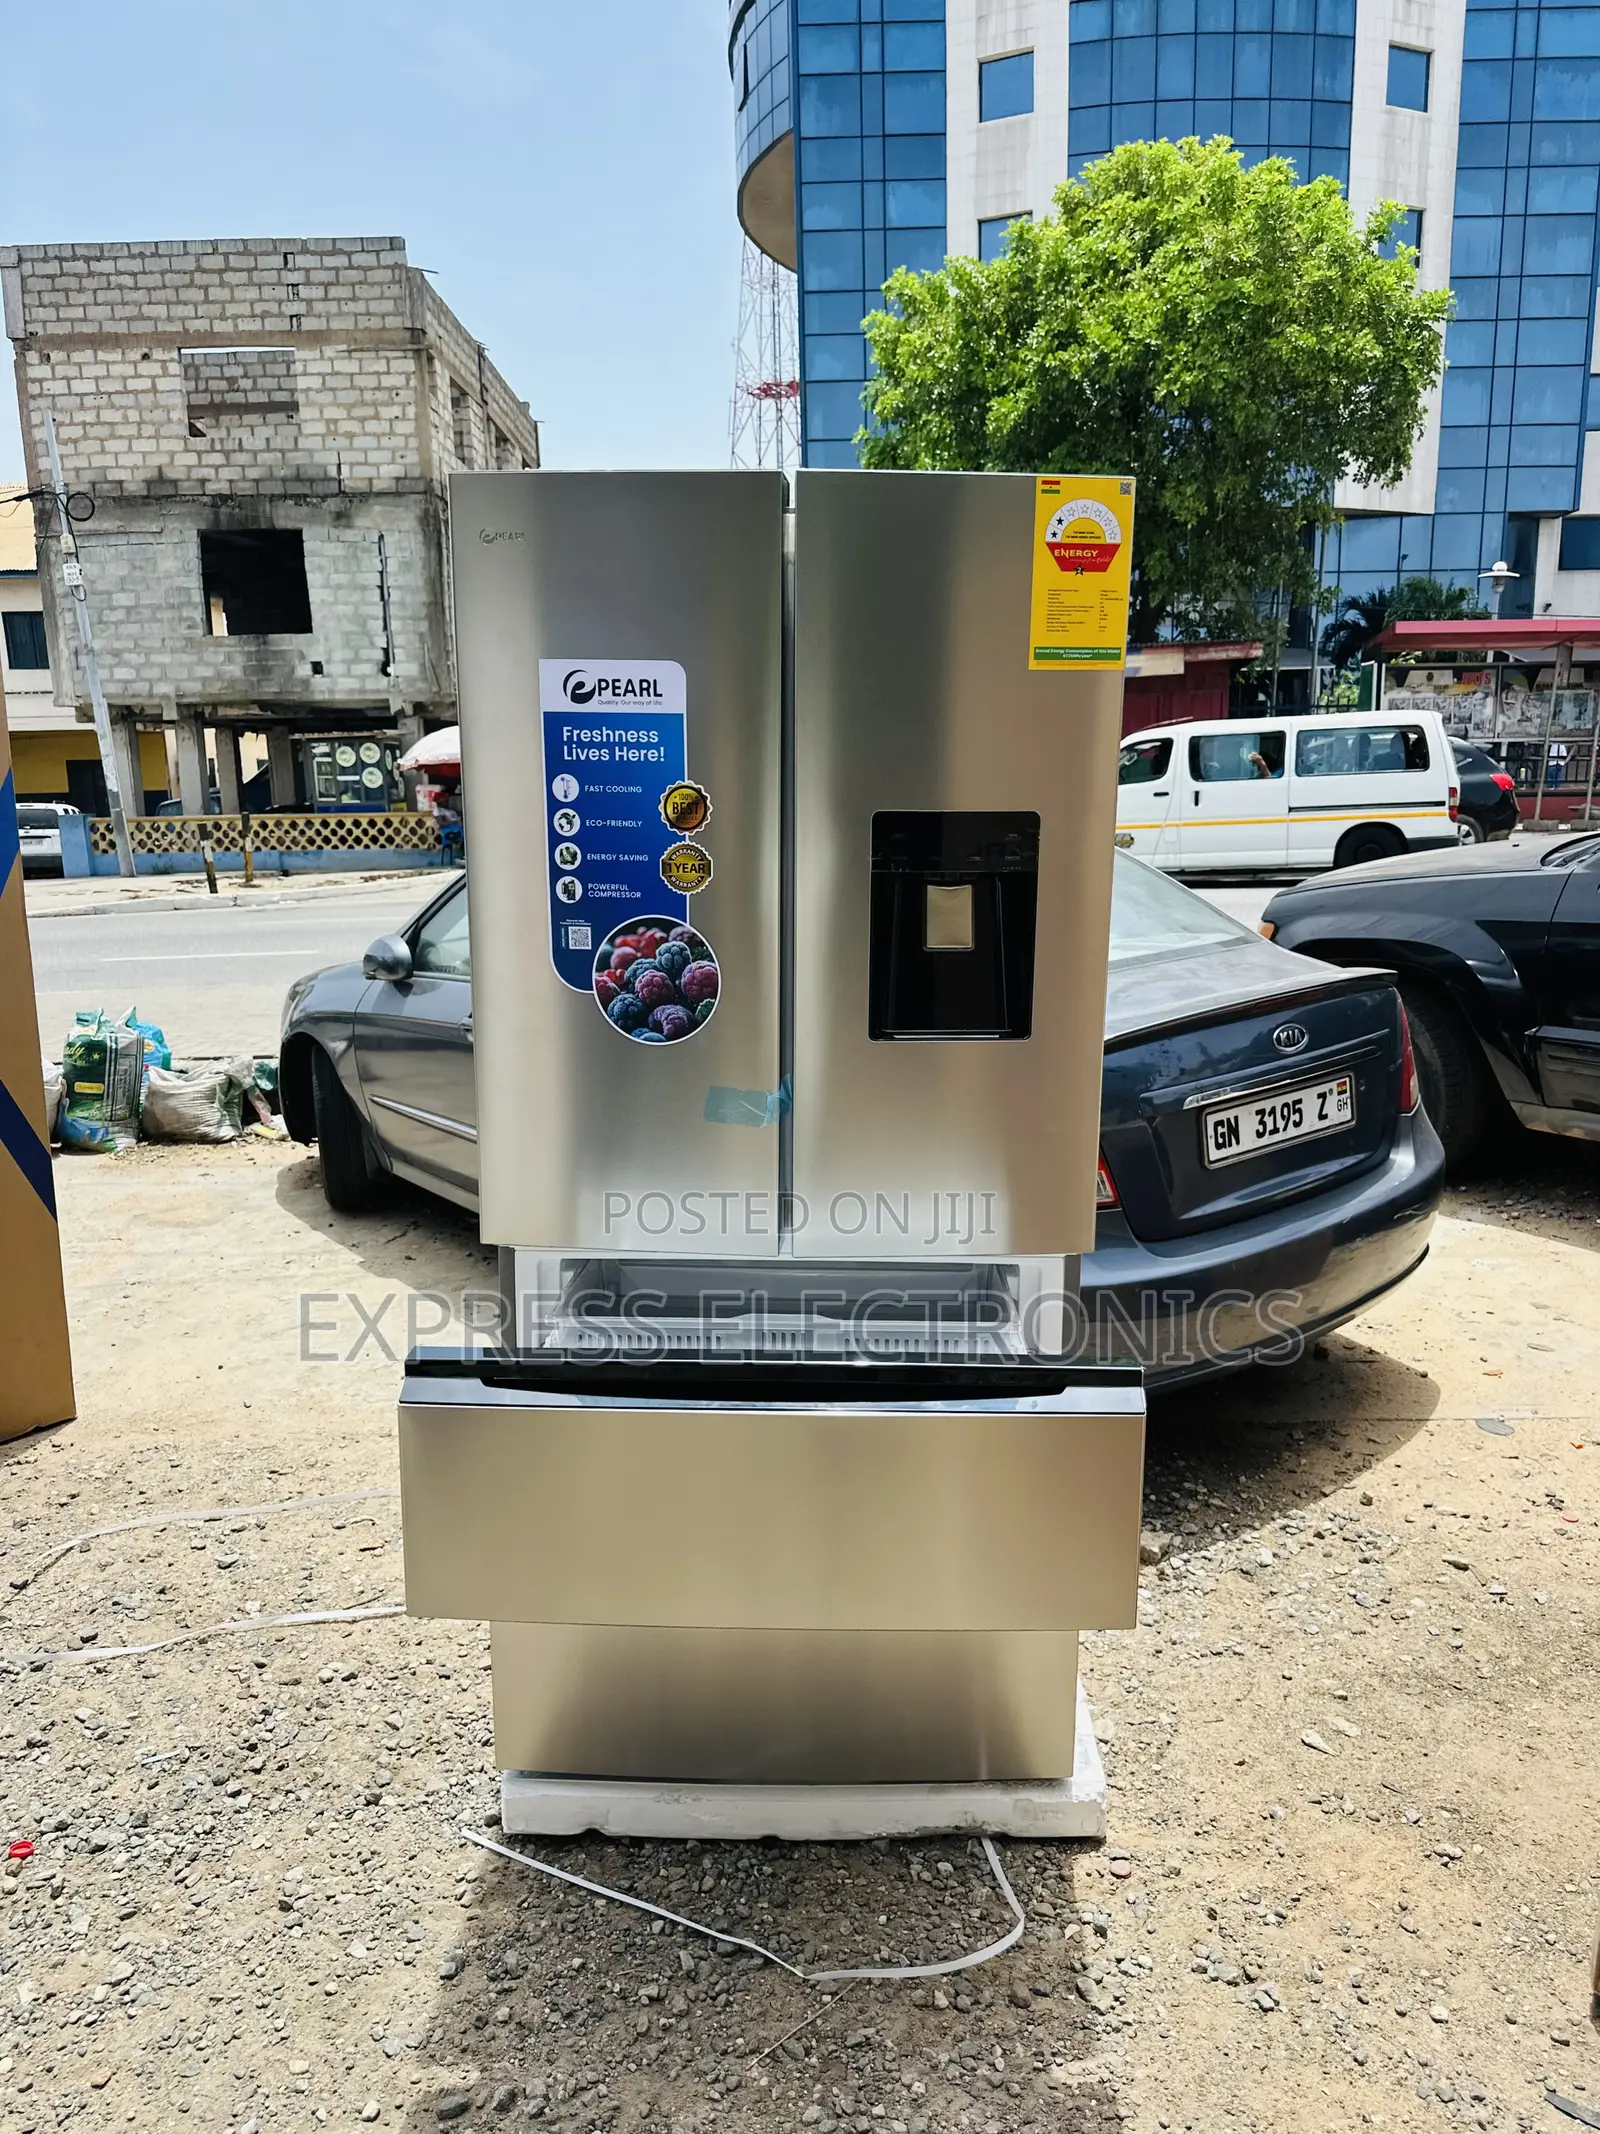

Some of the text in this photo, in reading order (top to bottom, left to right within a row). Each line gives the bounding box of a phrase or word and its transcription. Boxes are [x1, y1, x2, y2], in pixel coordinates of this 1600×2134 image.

[1054, 548, 1099, 559] ENERGY
[597, 678, 663, 698] PEARL
[562, 726, 659, 743] Freshness
[563, 744, 665, 762] Lives Here!
[585, 785, 642, 793] FAST COOLING
[678, 793, 693, 801] 100%
[672, 802, 700, 816] BEST
[586, 819, 642, 828] ECO-FRIENDLY
[587, 853, 649, 862] ENERGY SAVING
[670, 848, 702, 860] WARRANTY
[673, 863, 706, 874] YEAR
[588, 883, 629, 891] POWERFUL
[670, 875, 703, 888] WARRANTY
[588, 890, 642, 899] COMPRESSOR
[1279, 1028, 1303, 1047] KIA
[1336, 1097, 1349, 1113] GH
[1213, 1091, 1329, 1151] GN 3195 Z
